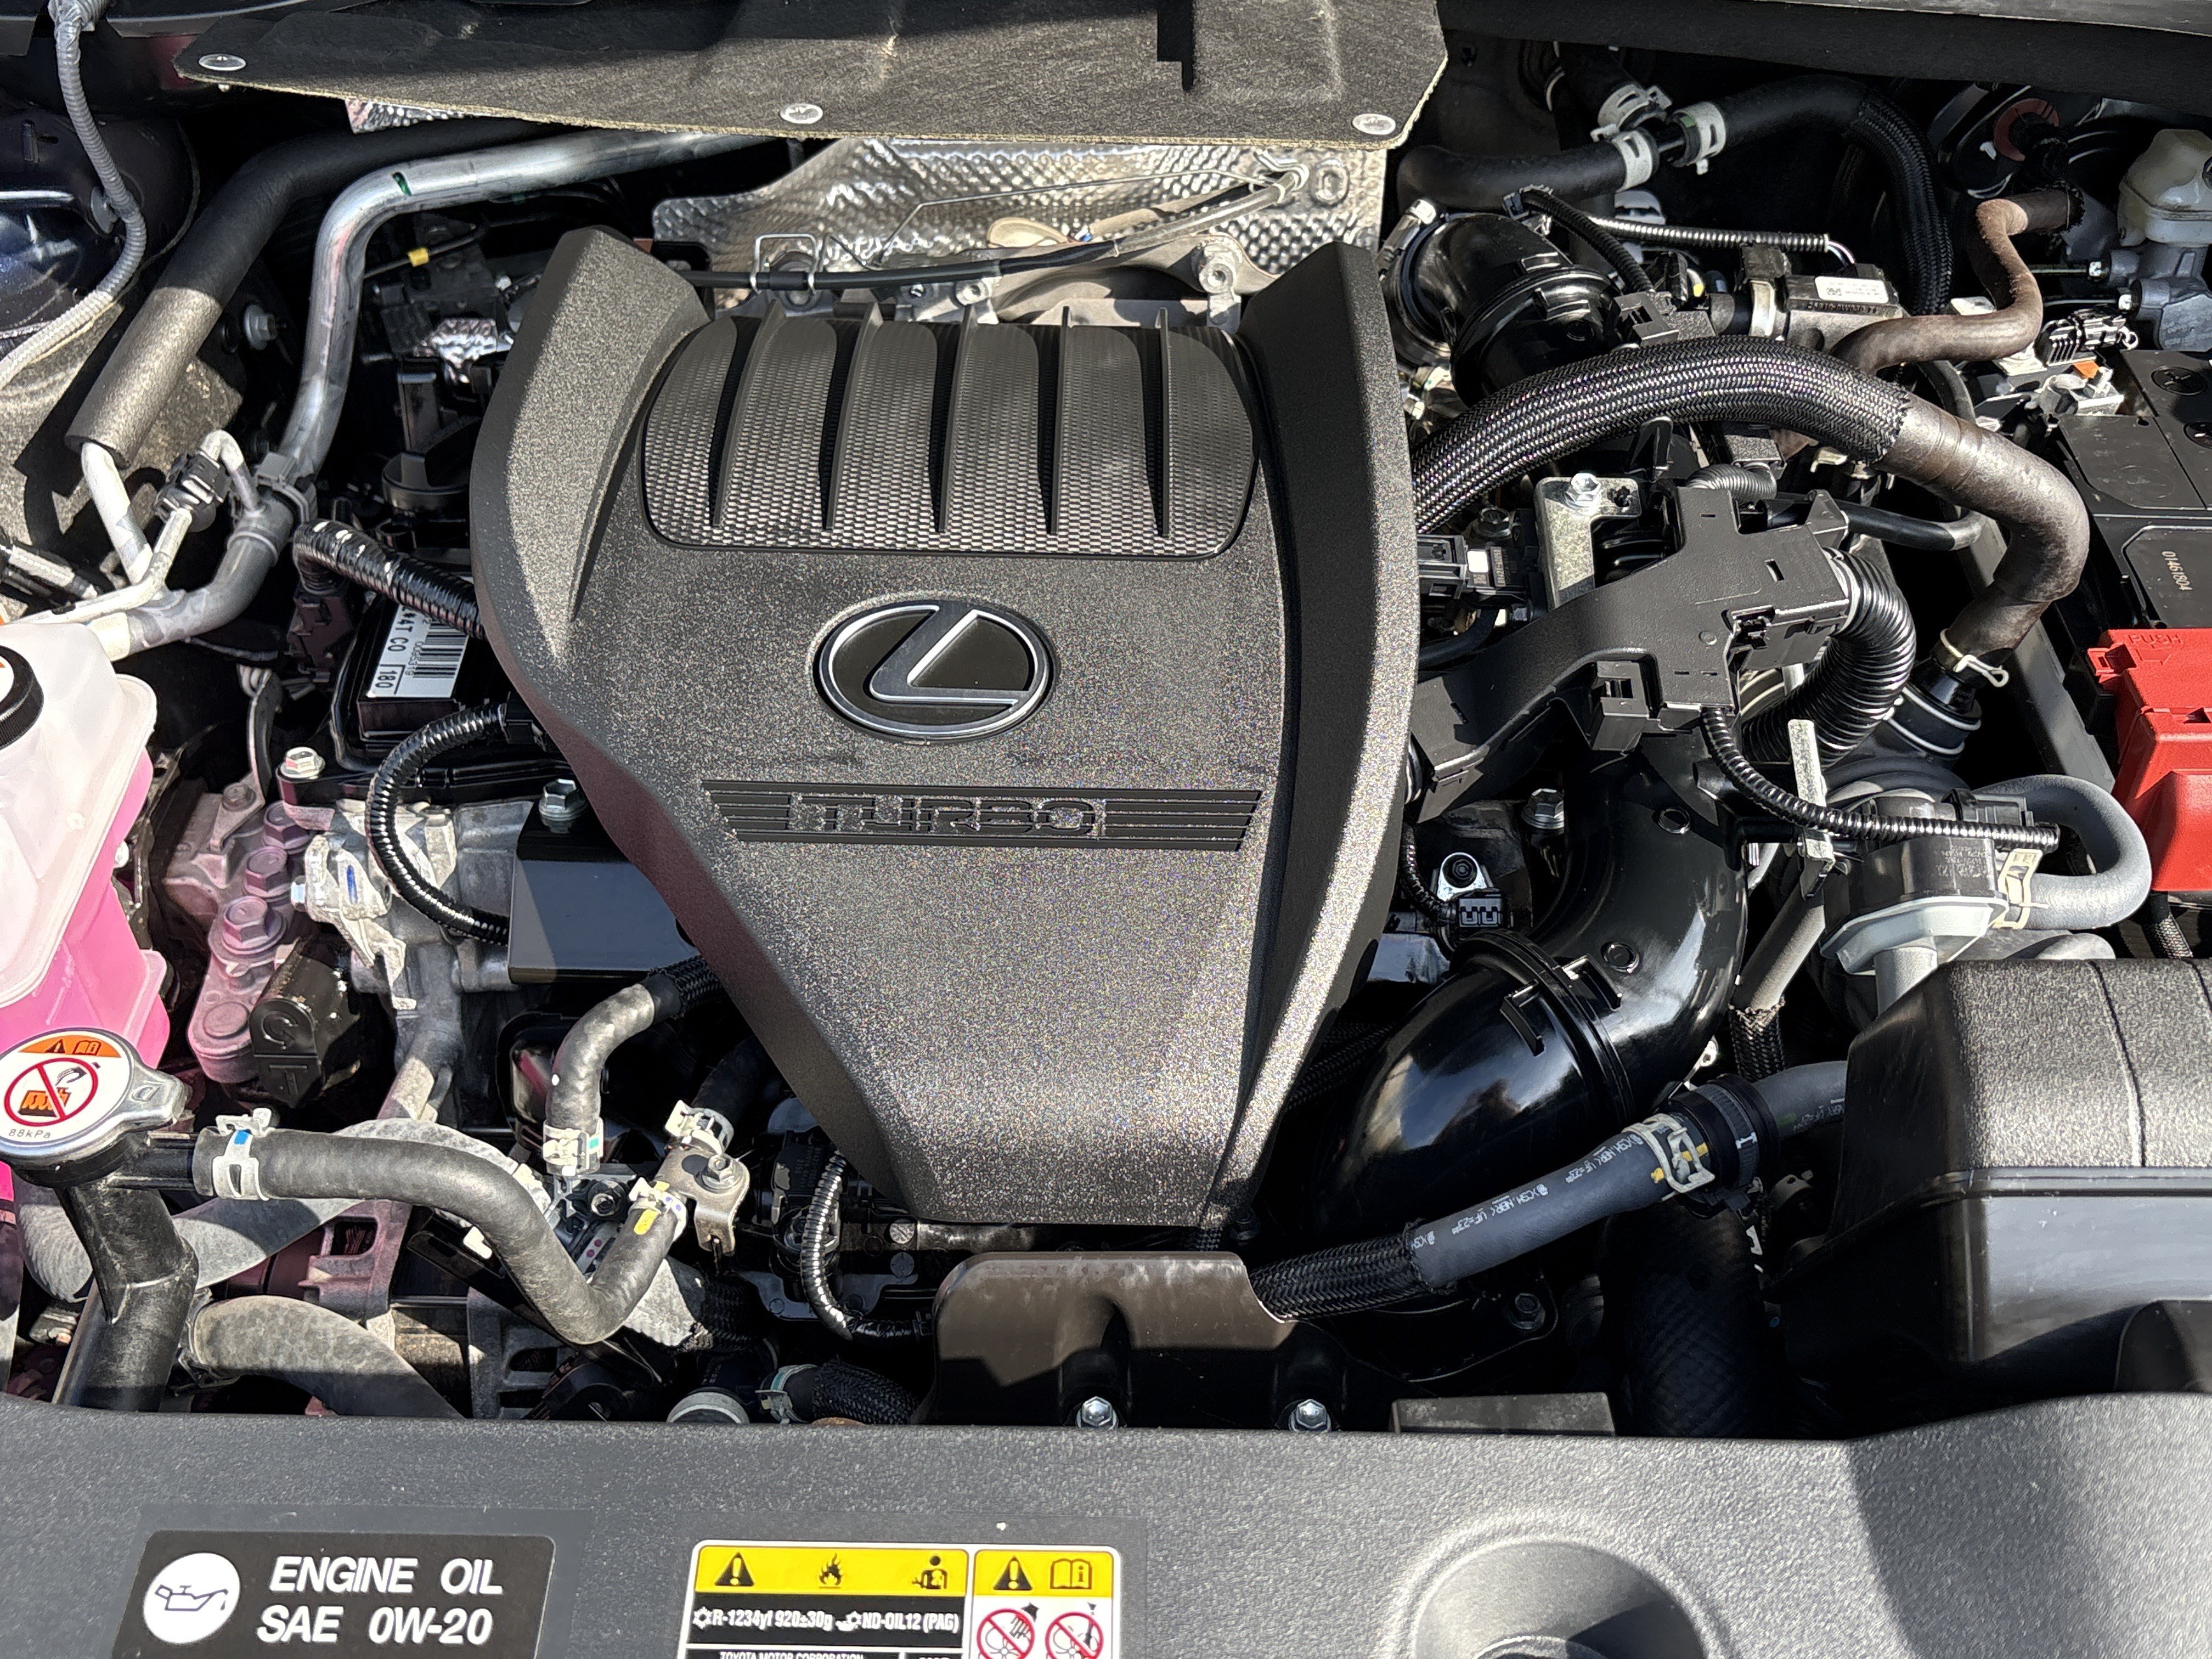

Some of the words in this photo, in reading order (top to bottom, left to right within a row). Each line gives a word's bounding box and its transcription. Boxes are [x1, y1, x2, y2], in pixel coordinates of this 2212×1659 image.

[2128, 633, 2182, 646] PUSH
[375, 670, 397, 688] 180
[801, 796, 1094, 834] TURBO
[8, 1128, 51, 1139] 88kPa
[269, 1556, 419, 1593] ENGINE
[441, 1558, 503, 1594] OIL
[256, 1605, 345, 1643] SAE
[368, 1606, 493, 1645] 0W-20
[713, 1609, 774, 1630] R-1234yf
[775, 1610, 833, 1632] 920±30g
[923, 1612, 959, 1633] (PAG)
